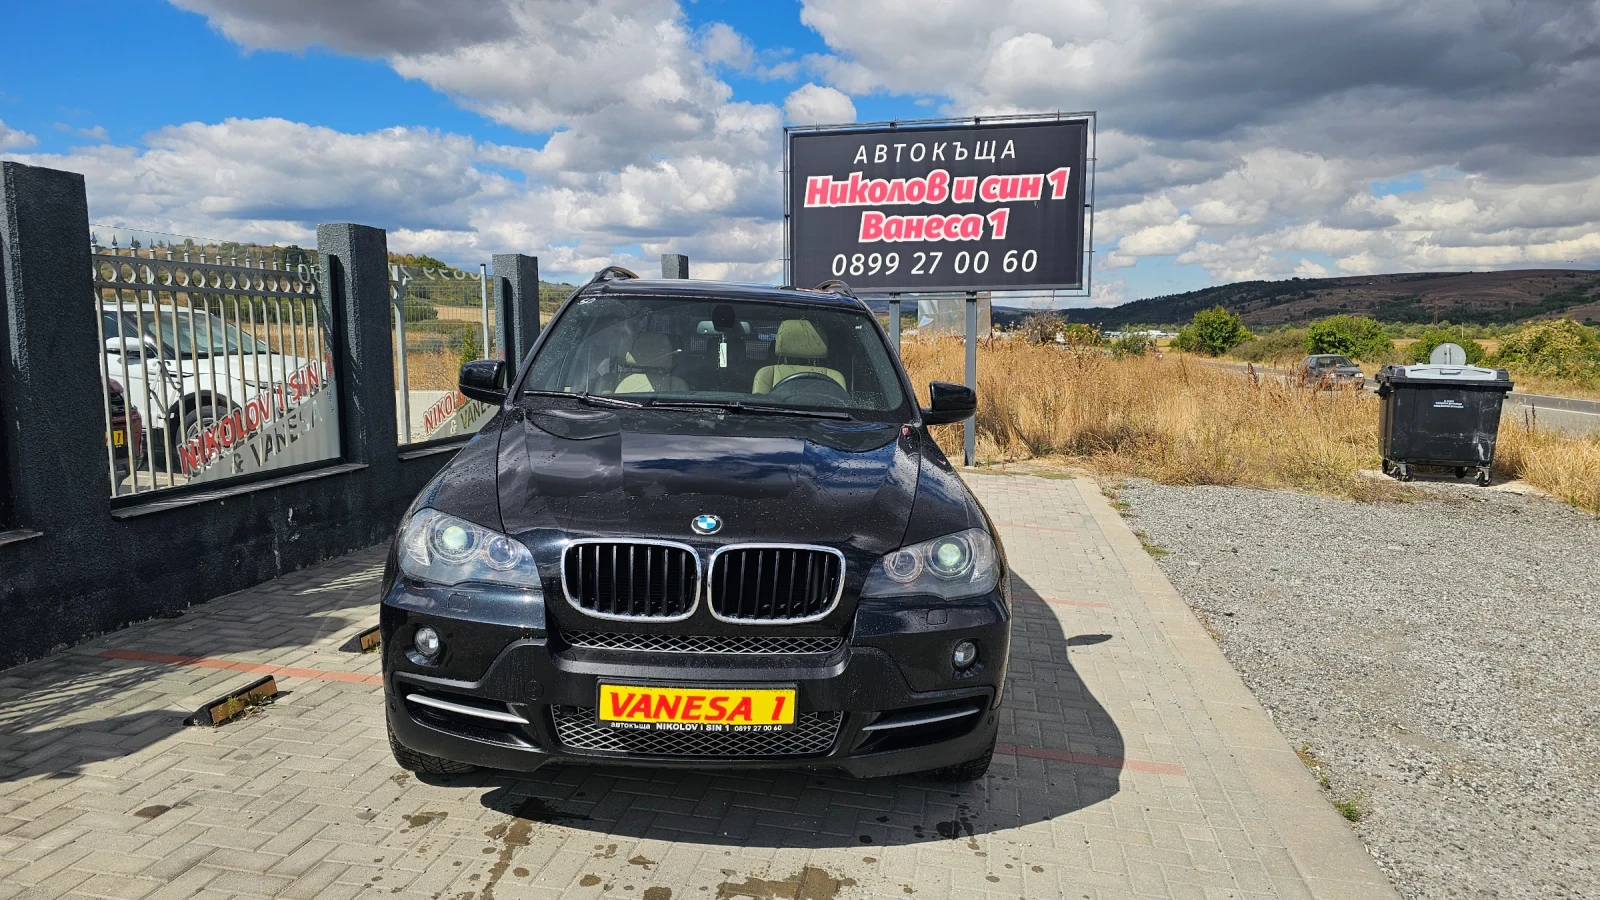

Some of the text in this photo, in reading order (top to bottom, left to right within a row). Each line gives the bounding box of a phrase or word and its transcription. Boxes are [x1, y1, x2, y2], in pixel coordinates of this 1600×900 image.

[854, 140, 1016, 164] АВТОКЪЩА
[804, 167, 1070, 207] Николов и син 1
[859, 208, 1010, 243] Ванеса 1
[832, 249, 1038, 276] 0899 27 00 60
[178, 389, 271, 477] NIKOLOV
[288, 360, 319, 403] SIN
[230, 452, 243, 474] &
[250, 400, 323, 467] VANESA
[610, 692, 786, 721] VANESA 1
[611, 722, 651, 730] автокъща
[656, 722, 698, 731] NIKOLOV
